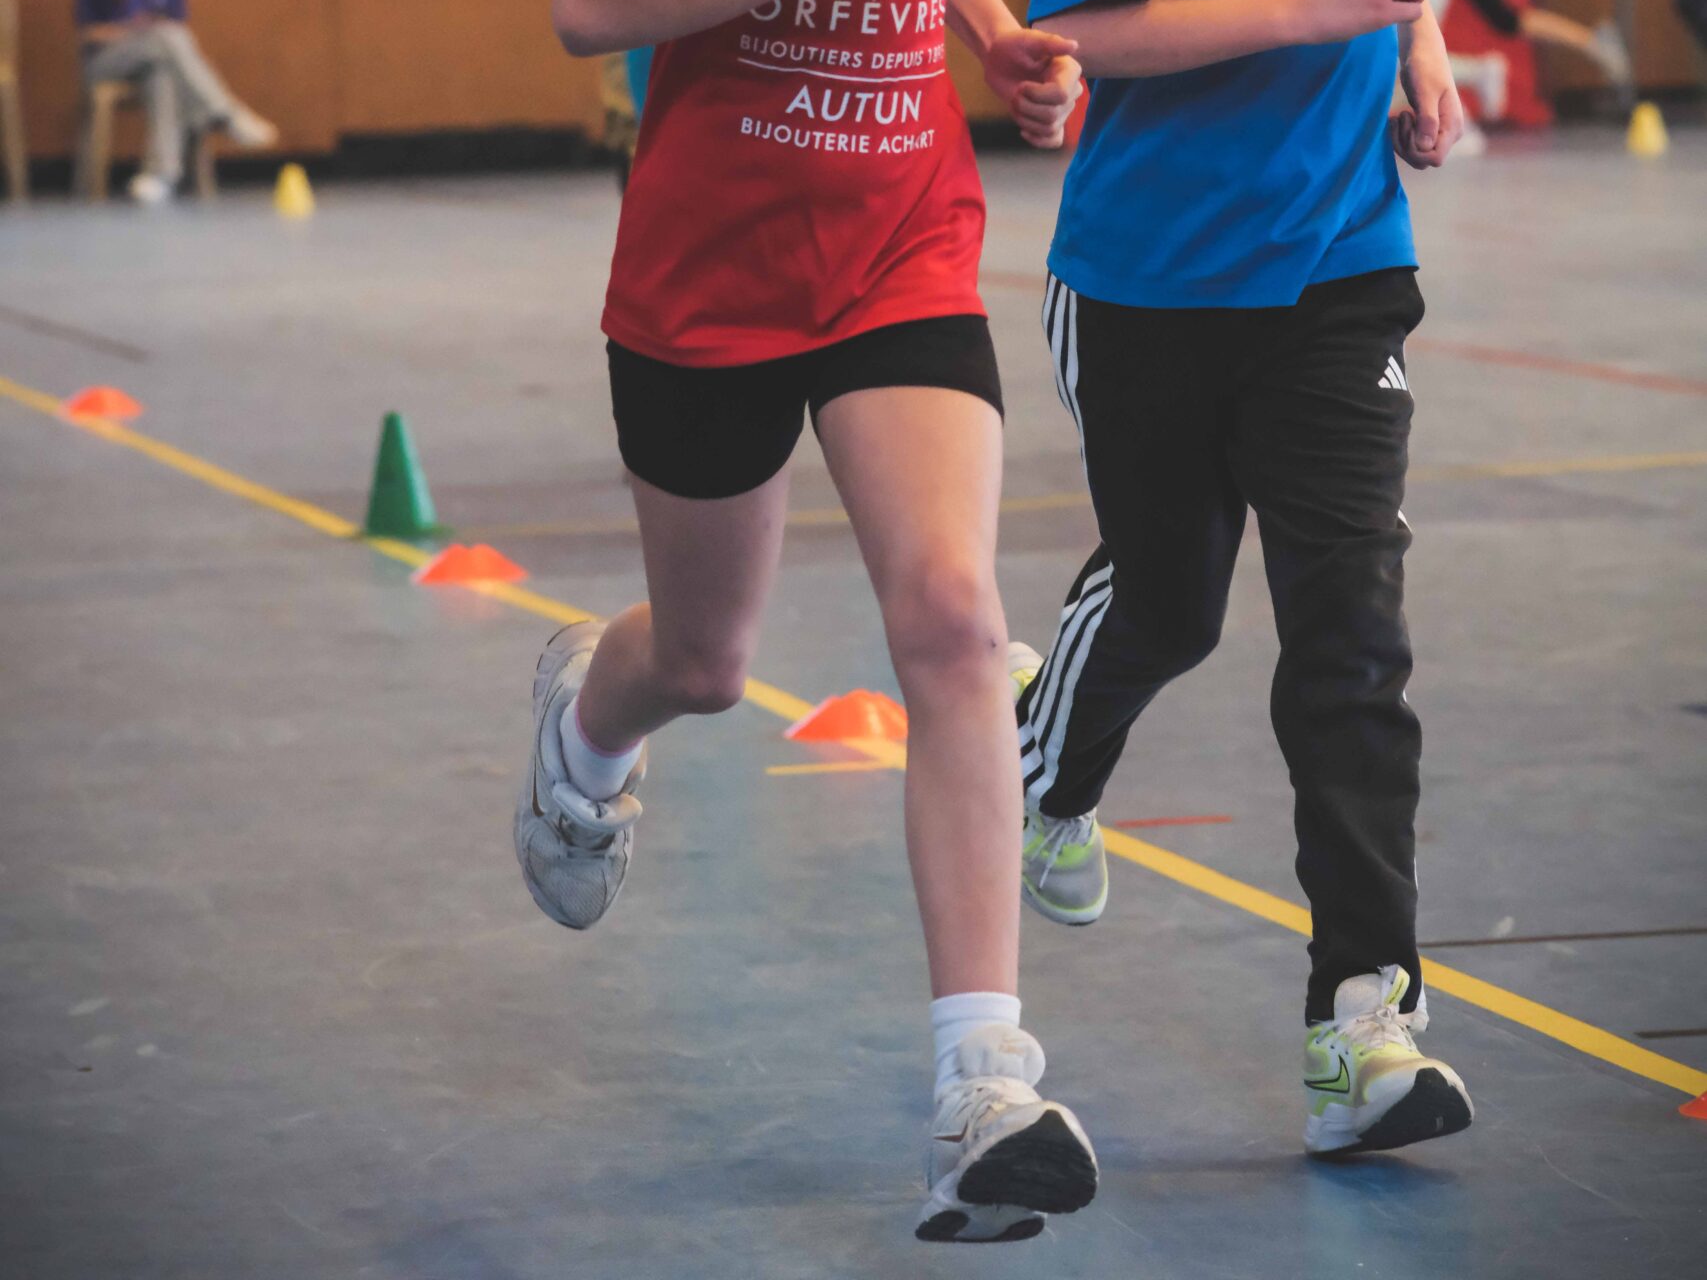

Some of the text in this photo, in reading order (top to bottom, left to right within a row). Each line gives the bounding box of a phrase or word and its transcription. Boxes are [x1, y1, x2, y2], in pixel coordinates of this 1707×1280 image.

[740, 34, 864, 68] BIJOUTIERS
[871, 50, 925, 70] DEPUIS
[785, 84, 923, 125] AUTUN
[740, 117, 870, 154] BIJOUTERIE
